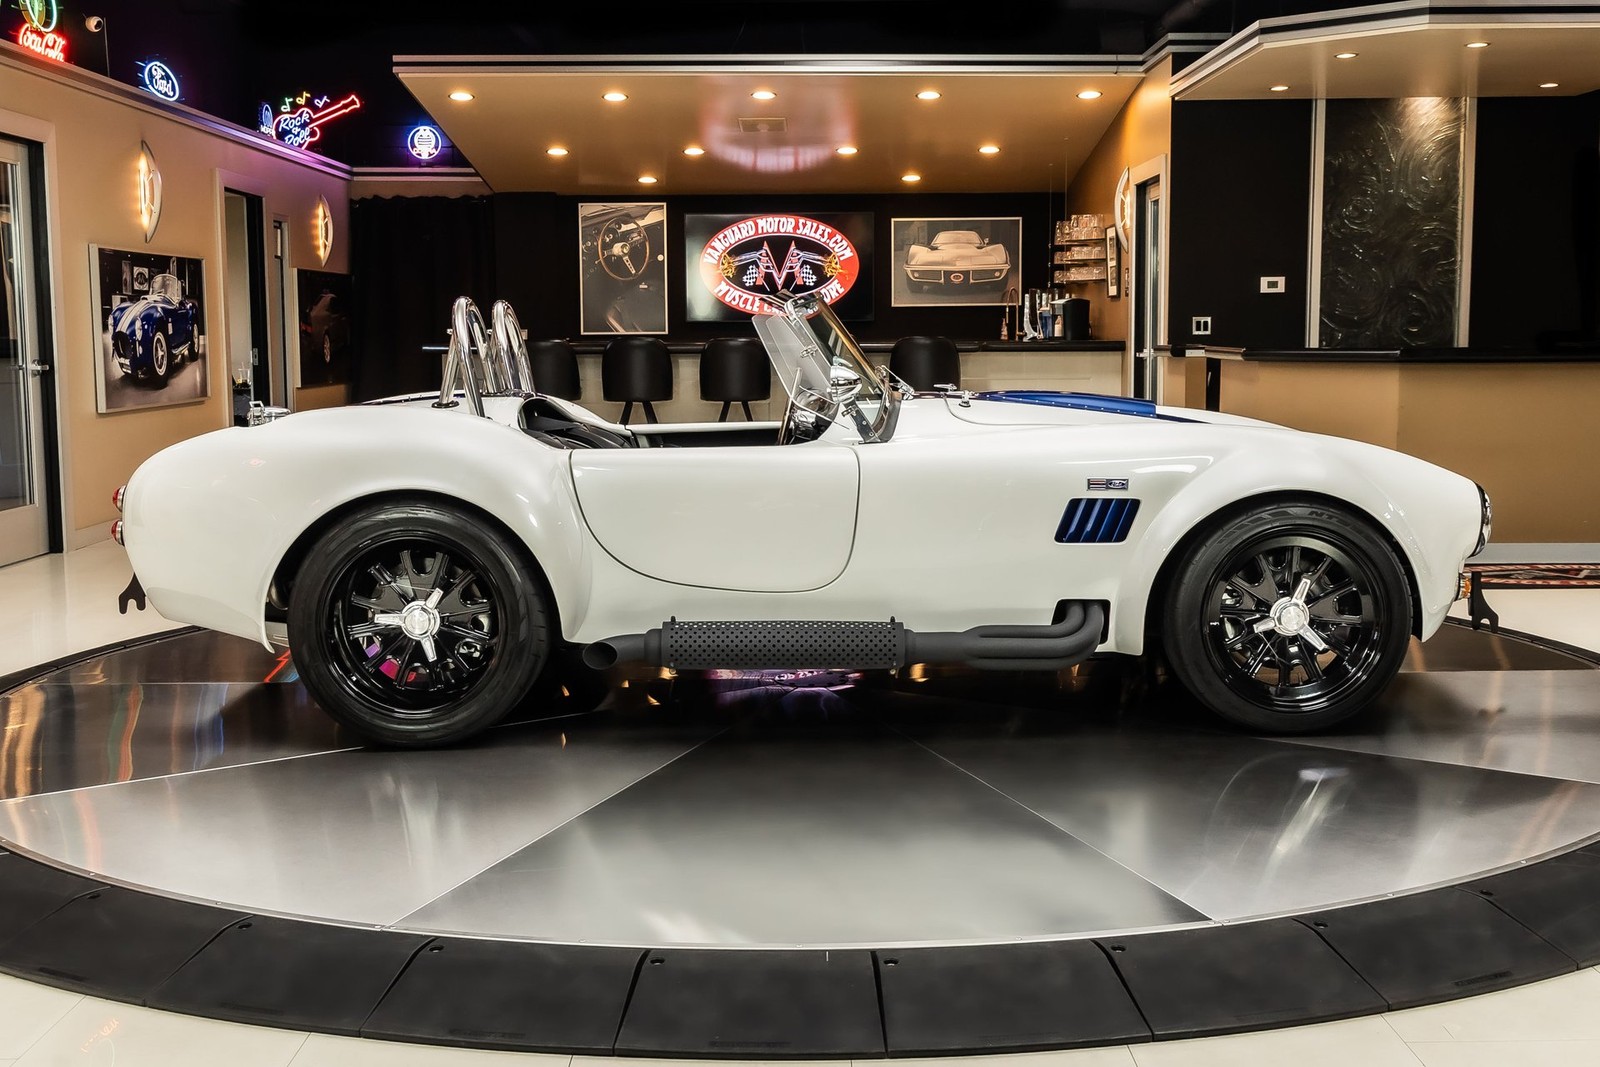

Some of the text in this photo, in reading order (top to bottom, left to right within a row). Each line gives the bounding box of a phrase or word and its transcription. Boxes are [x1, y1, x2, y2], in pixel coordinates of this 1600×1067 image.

[151, 65, 174, 97] Ford
[278, 109, 311, 132] Rock
[703, 217, 855, 265] VANGUARD MOTOR SALES.COM
[713, 281, 762, 313] MUSCLE
